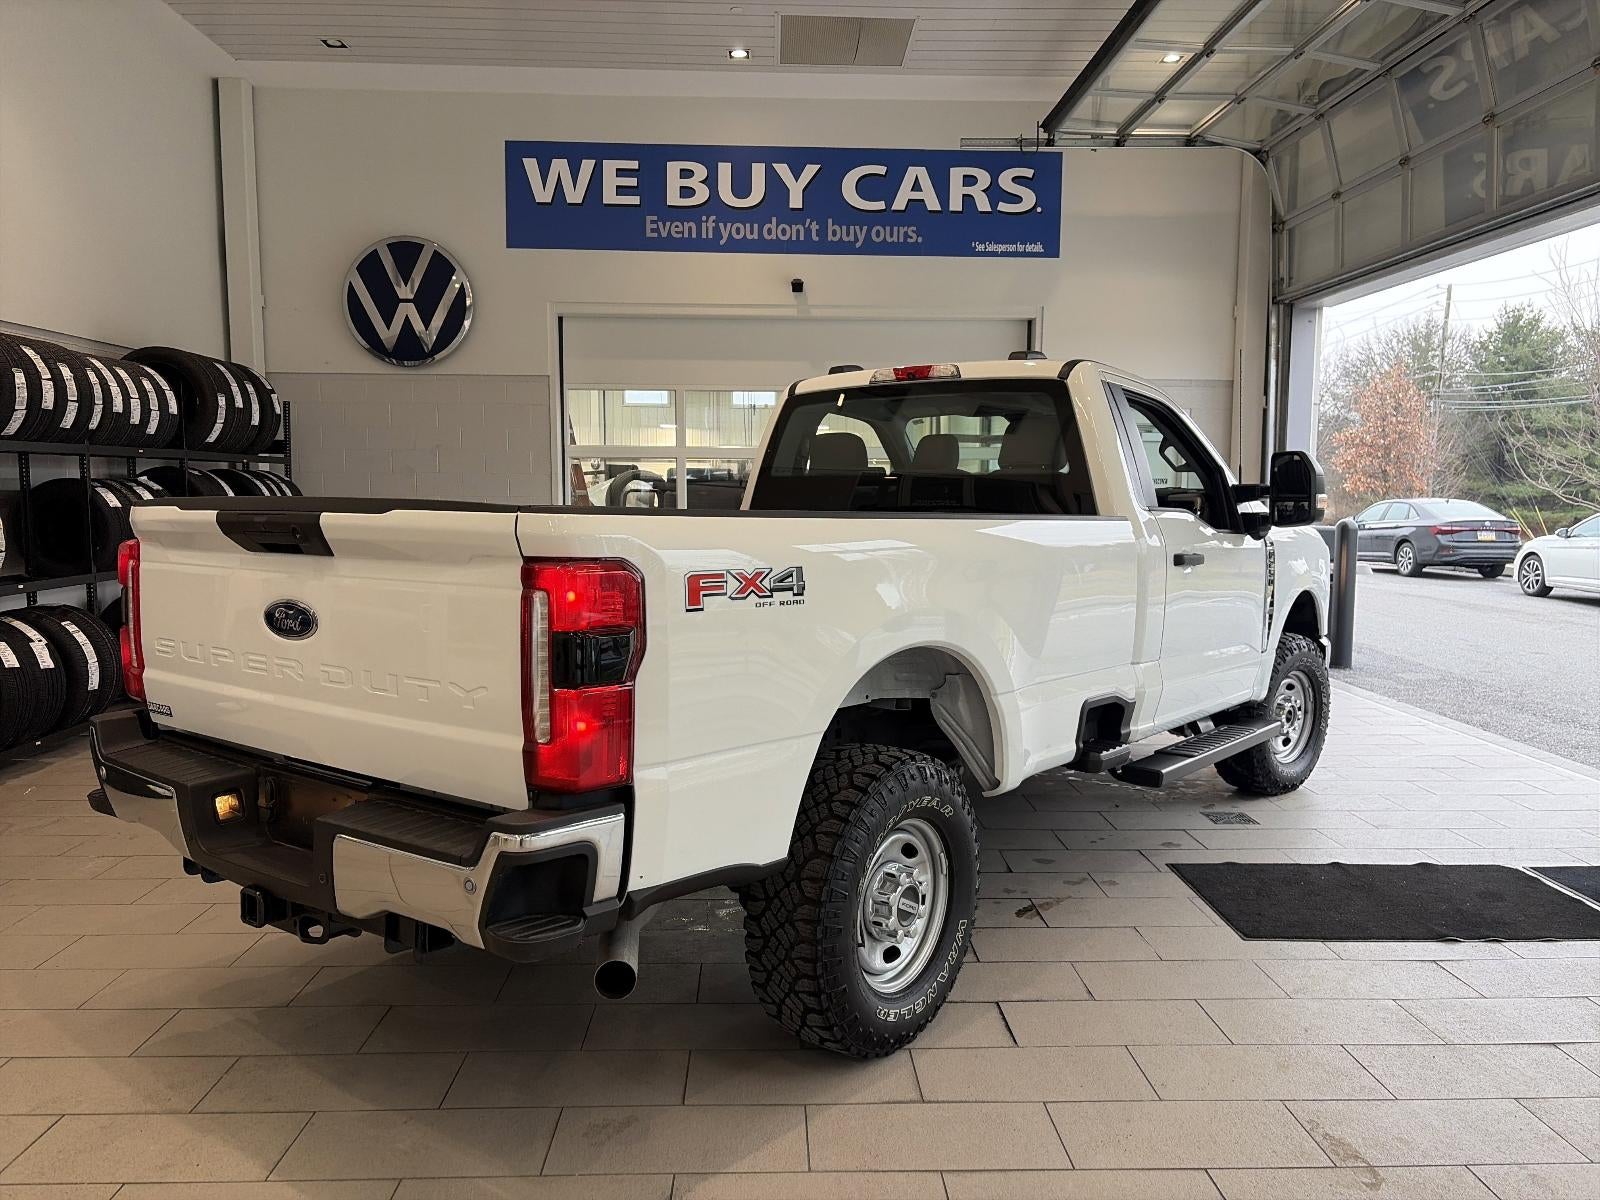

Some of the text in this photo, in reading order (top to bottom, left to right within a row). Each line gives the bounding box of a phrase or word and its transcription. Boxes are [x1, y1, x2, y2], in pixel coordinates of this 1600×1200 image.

[522, 157, 1043, 214] WE BUY CARS.
[645, 215, 923, 248] Even if you don't buy ours.
[975, 241, 1045, 254] See Salesperson for details.
[684, 566, 805, 612] FX4
[779, 599, 805, 607] ROAD
[155, 637, 489, 711] SUPER DUTY
[877, 919, 968, 1022] WRANGLER
